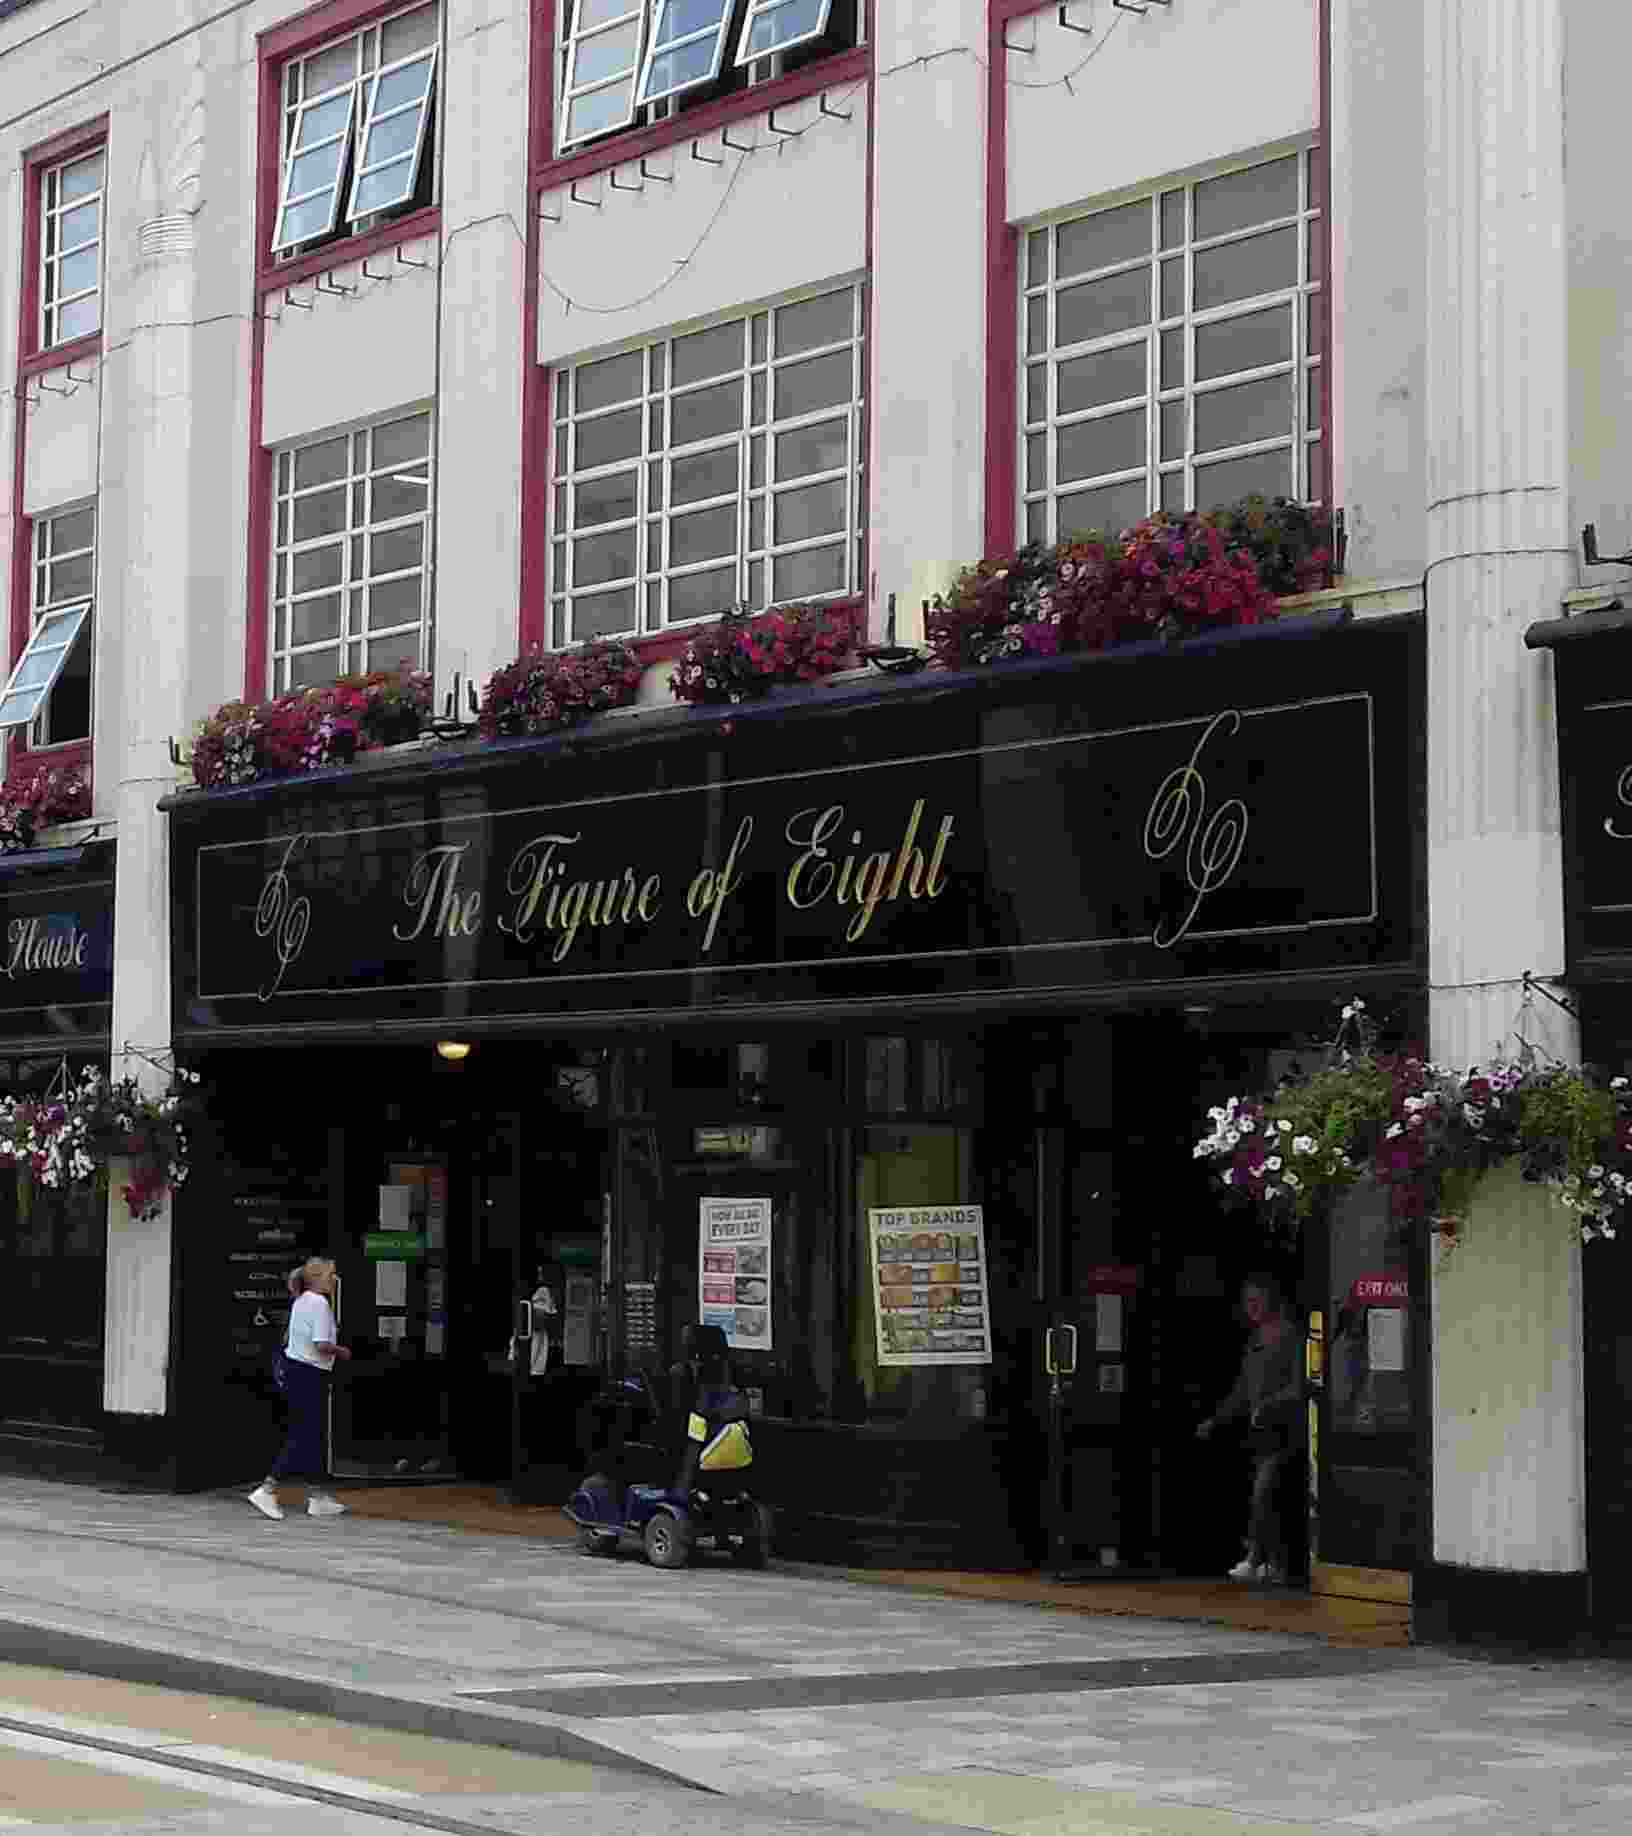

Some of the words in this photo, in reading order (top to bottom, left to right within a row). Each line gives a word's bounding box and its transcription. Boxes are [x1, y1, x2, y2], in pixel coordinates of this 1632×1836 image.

[392, 840, 481, 941] The
[497, 831, 661, 963] Figure
[686, 815, 754, 951] of
[785, 799, 956, 944] Eight
[879, 1213, 906, 1226] TOP
[911, 1209, 978, 1226] BRANDS
